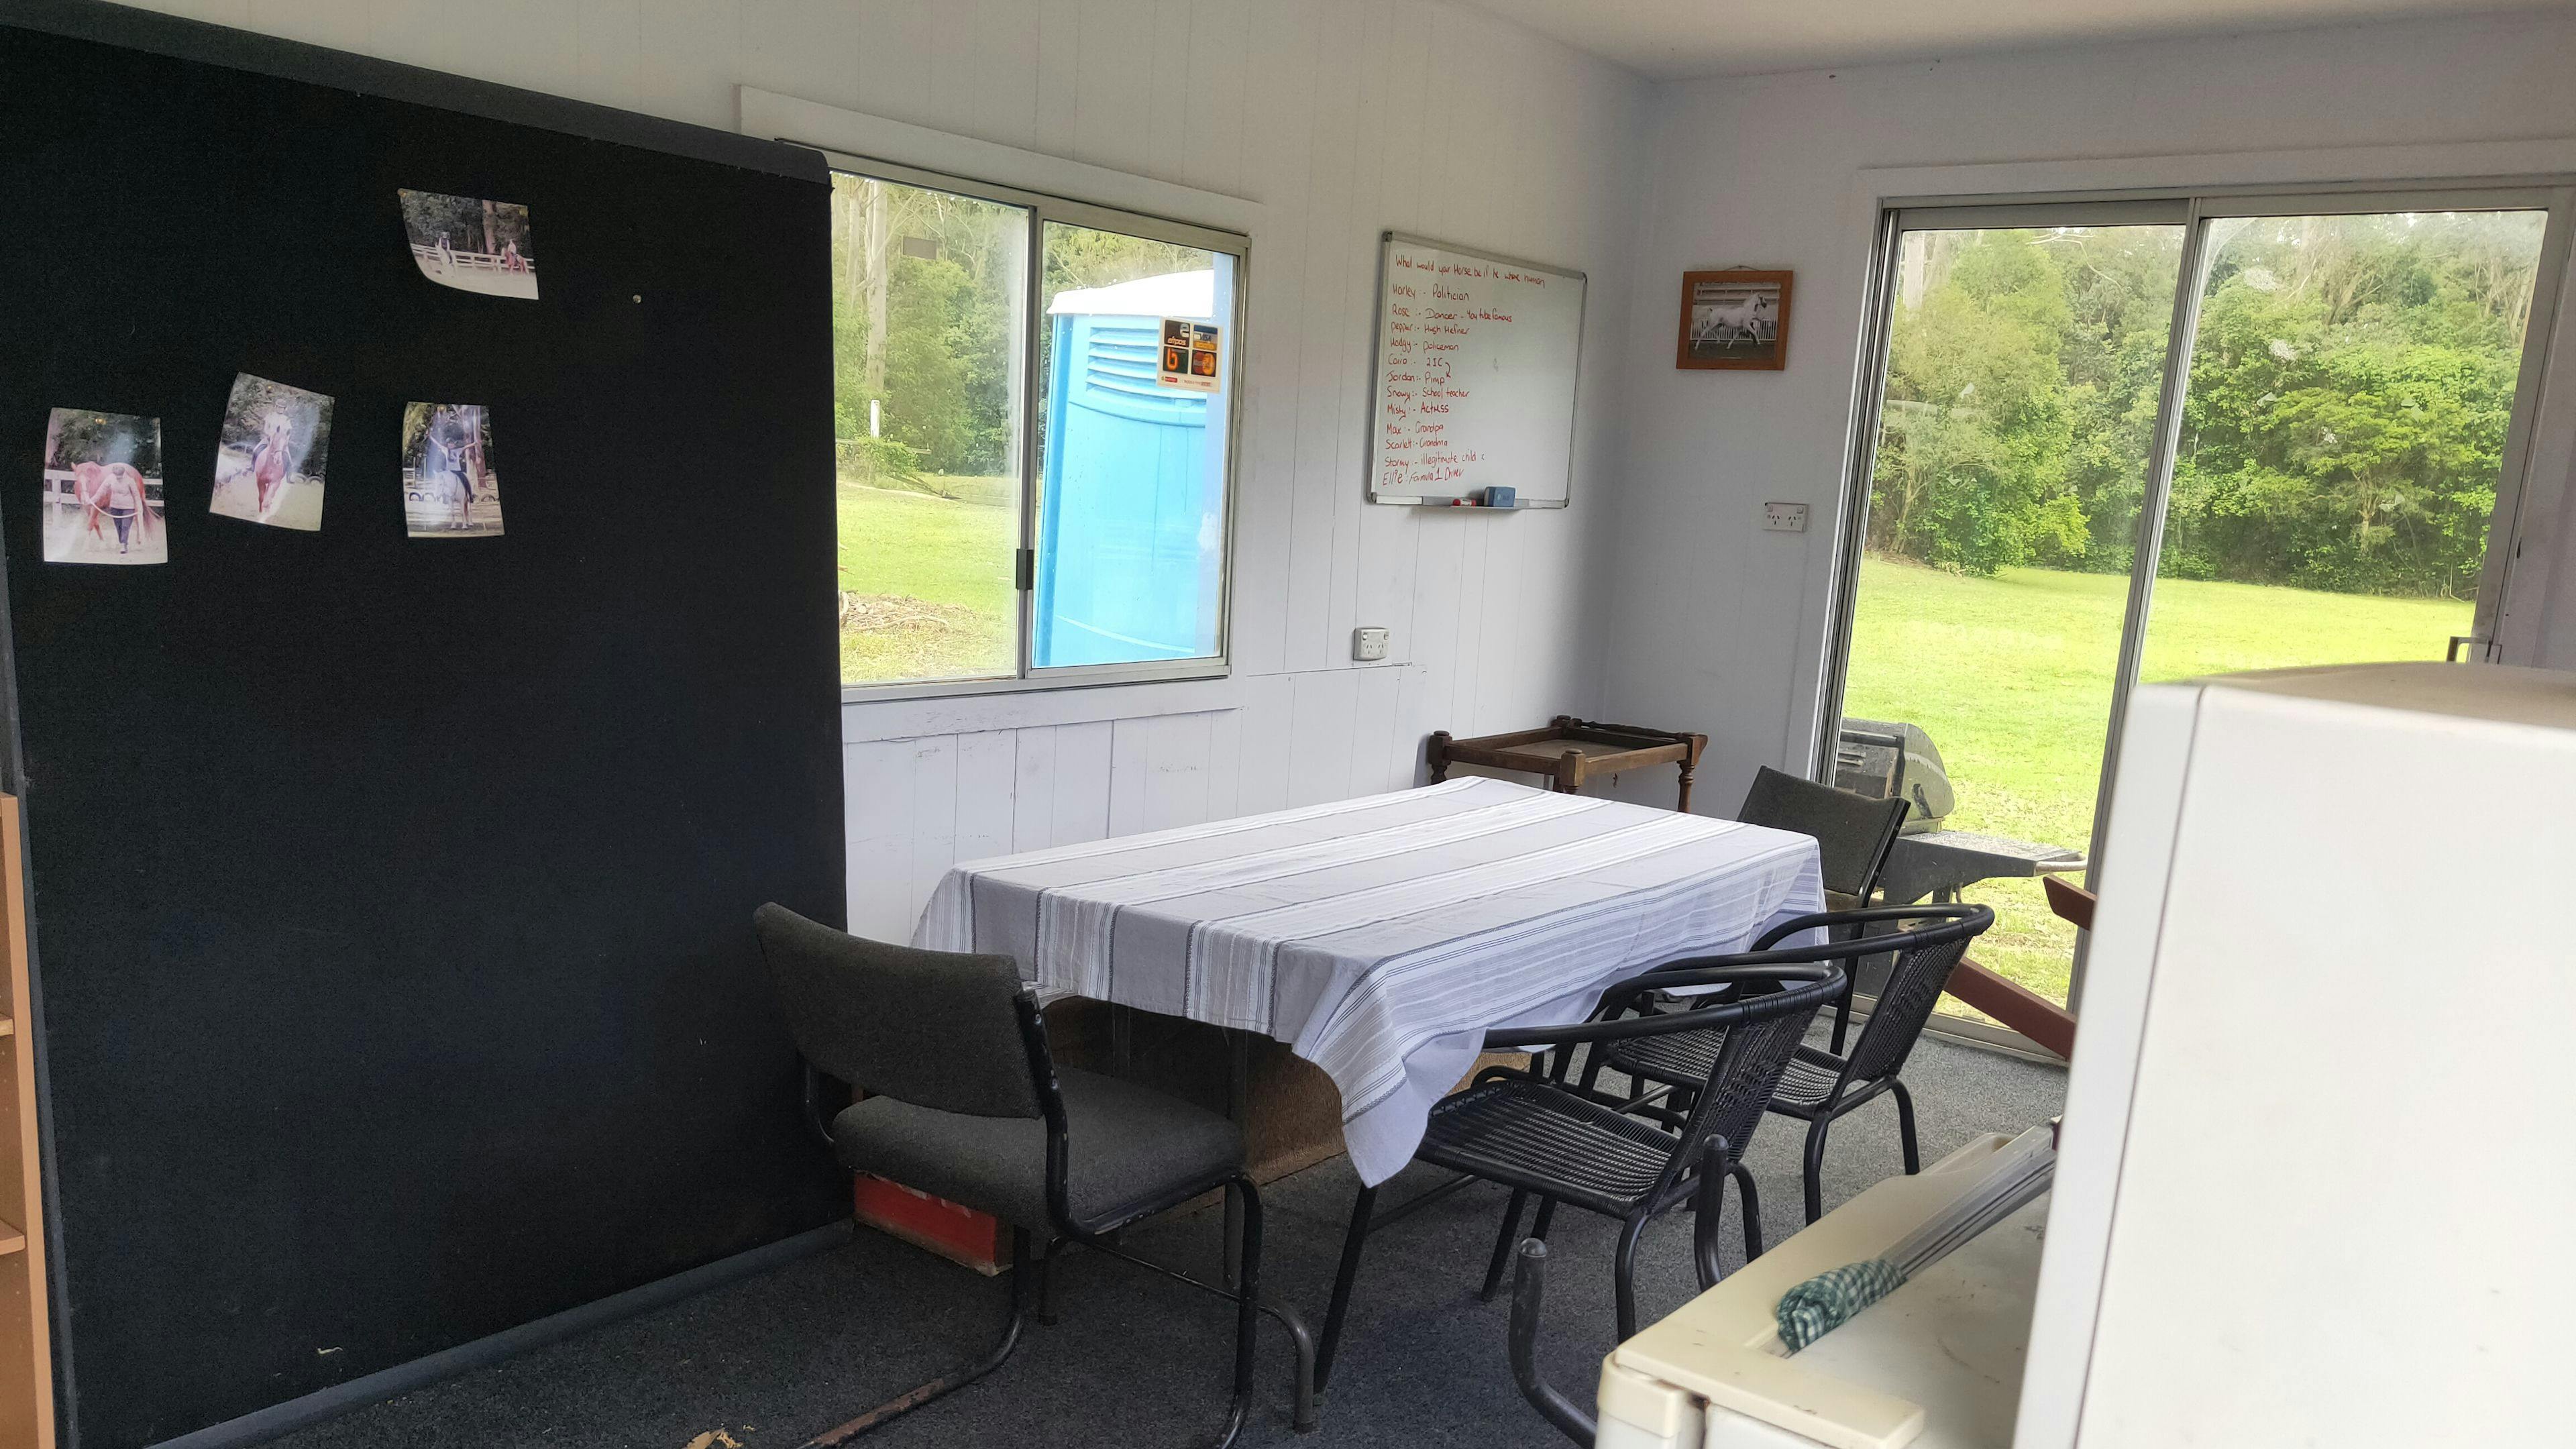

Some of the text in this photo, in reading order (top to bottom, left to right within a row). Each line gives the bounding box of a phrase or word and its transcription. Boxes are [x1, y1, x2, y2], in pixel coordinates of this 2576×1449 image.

[1395, 254, 1412, 268] What
[1416, 260, 1434, 272] would
[1432, 282, 1469, 301] Politician
[1392, 303, 1410, 317] Rose
[1424, 308, 1458, 320] Dancer
[1424, 323, 1441, 335] Hugh
[1387, 370, 1415, 382] Jordan
[1424, 371, 1445, 386] Pimp
[1387, 385, 1411, 404] Snowy
[1420, 401, 1449, 415] Actress
[1387, 422, 1402, 435] Max
[1415, 421, 1444, 437] Grandpa
